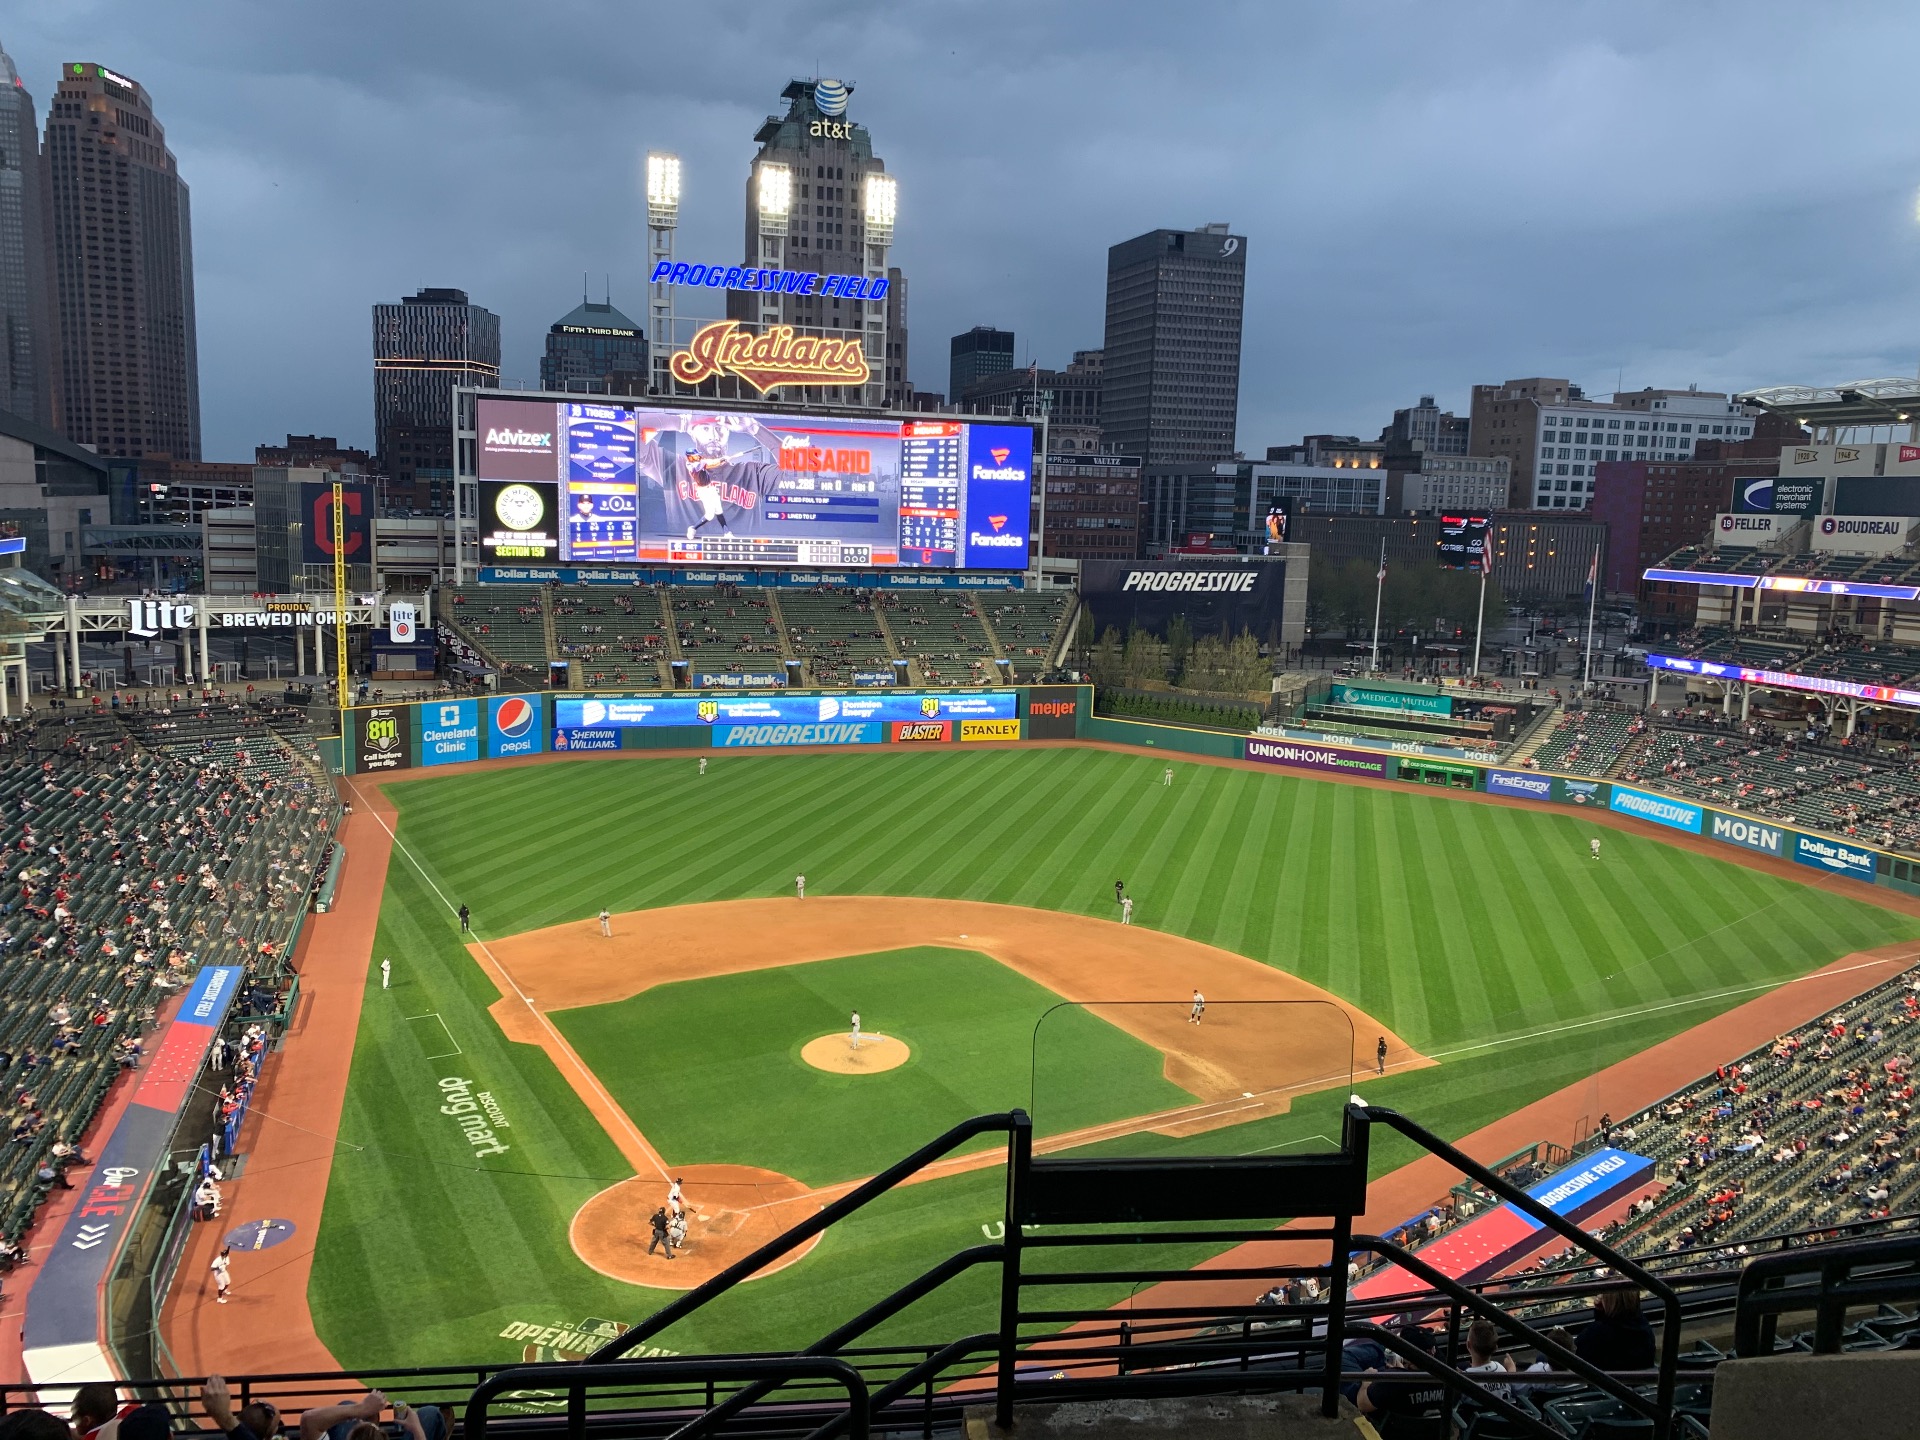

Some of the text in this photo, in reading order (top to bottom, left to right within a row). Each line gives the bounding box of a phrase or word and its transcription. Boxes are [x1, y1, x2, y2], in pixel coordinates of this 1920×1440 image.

[810, 119, 852, 140] at&t
[1222, 238, 1239, 257] 9
[650, 260, 890, 301] PROGRESSIVE FIELD
[563, 325, 634, 337] FIFTH THIRD BANK
[670, 320, 869, 390] Indians
[585, 408, 616, 419] TIGERS
[485, 428, 552, 447] Advizex
[1902, 449, 1917, 458] 1954
[778, 447, 872, 476] ROSARIO
[1093, 457, 1121, 465] VAULTZ
[973, 465, 1026, 481] Fanatics
[1777, 484, 1813, 493] electronic
[1776, 493, 1811, 501] merchant
[1775, 501, 1808, 510] systems
[1723, 519, 1732, 528] 19
[1734, 518, 1771, 530] FELLER
[1837, 521, 1900, 535] BOUDREAU
[971, 532, 1023, 547] Fanatics
[496, 546, 530, 556] SECTION
[494, 569, 528, 578] Dollar
[577, 570, 610, 580] Dollar
[686, 572, 717, 581] Dollar
[790, 573, 821, 582] Dollar
[890, 576, 918, 584] Dollar
[1122, 571, 1259, 592] PROGRESSIVE
[267, 602, 312, 612] PROUDLY
[126, 599, 194, 638] Lite
[222, 613, 292, 628] BREWED
[295, 612, 312, 626] IN
[392, 609, 413, 622] Lite
[703, 674, 742, 686] Dollar
[842, 701, 882, 709] Dominion
[922, 698, 939, 712] 811
[1361, 692, 1438, 708] MEDICAL MUTUAL
[608, 704, 654, 713] Dominion
[698, 701, 717, 716] 811
[1030, 700, 1076, 718] meijer
[369, 720, 395, 740] 811
[423, 726, 477, 742] Cleveland
[571, 730, 615, 740] SHERWIN
[725, 724, 868, 746] PROGRESSIVE
[900, 724, 943, 740] BLASTER
[962, 724, 1018, 736] STANLEY
[1257, 726, 1286, 737] MOEN
[1322, 734, 1353, 745] MOEN
[435, 742, 466, 754] Clinic
[500, 739, 532, 754] pepsi
[1391, 742, 1424, 754] MOEN
[378, 752, 402, 760] before
[1464, 750, 1499, 763] MOEN
[330, 766, 343, 774] 325
[1336, 759, 1383, 772] MORTGAGE
[1492, 773, 1550, 793] FirstEnergy
[1614, 792, 1697, 826] PROGRESSIVE
[1713, 816, 1778, 851] MOEN
[1800, 838, 1837, 858] Dollar
[1837, 848, 1872, 868] Bank
[476, 1090, 510, 1128] DISCOUNT
[438, 1077, 510, 1158] drug mart
[1590, 1155, 1626, 1176] FIELD
